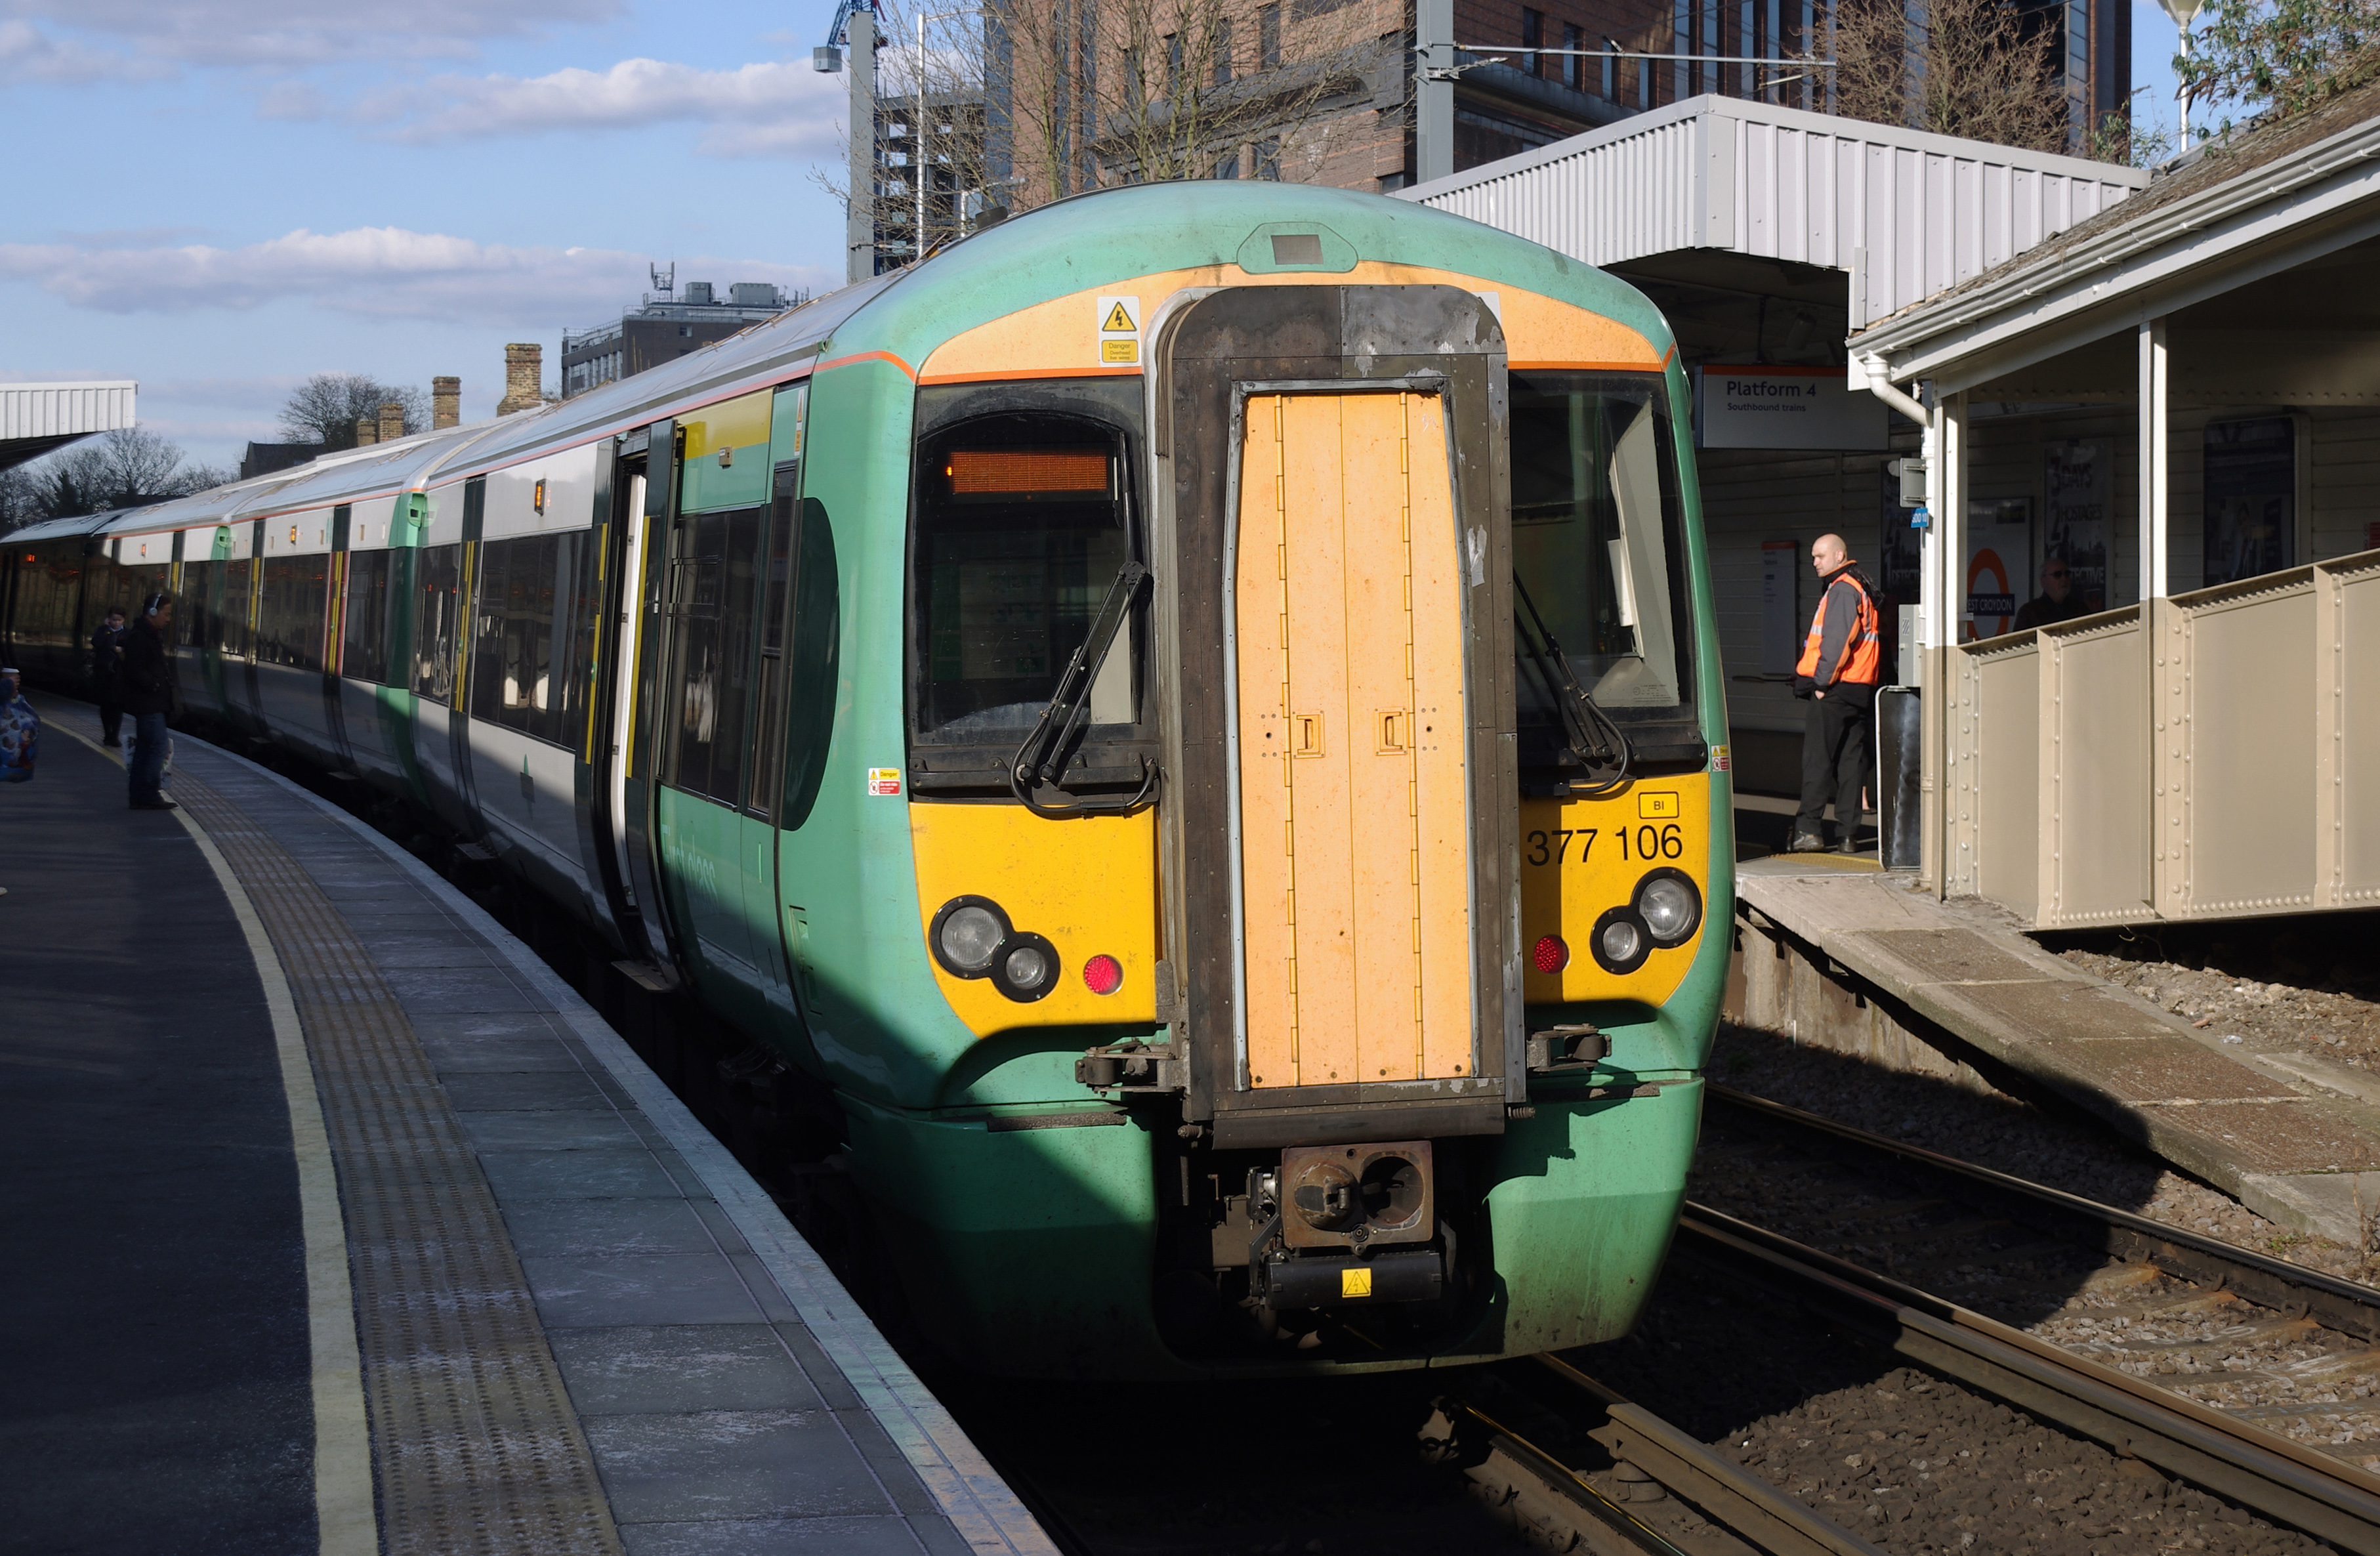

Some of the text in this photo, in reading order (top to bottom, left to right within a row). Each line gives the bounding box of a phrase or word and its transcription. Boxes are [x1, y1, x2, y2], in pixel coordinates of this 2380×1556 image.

[1726, 381, 1816, 396] Platform 4
[1727, 403, 1780, 411] Southbound
[2062, 463, 2093, 489] DAYS
[2061, 503, 2102, 522] HOSTAGES
[1968, 598, 2013, 612] EST CROYDON
[1527, 824, 1682, 866] 377 106
